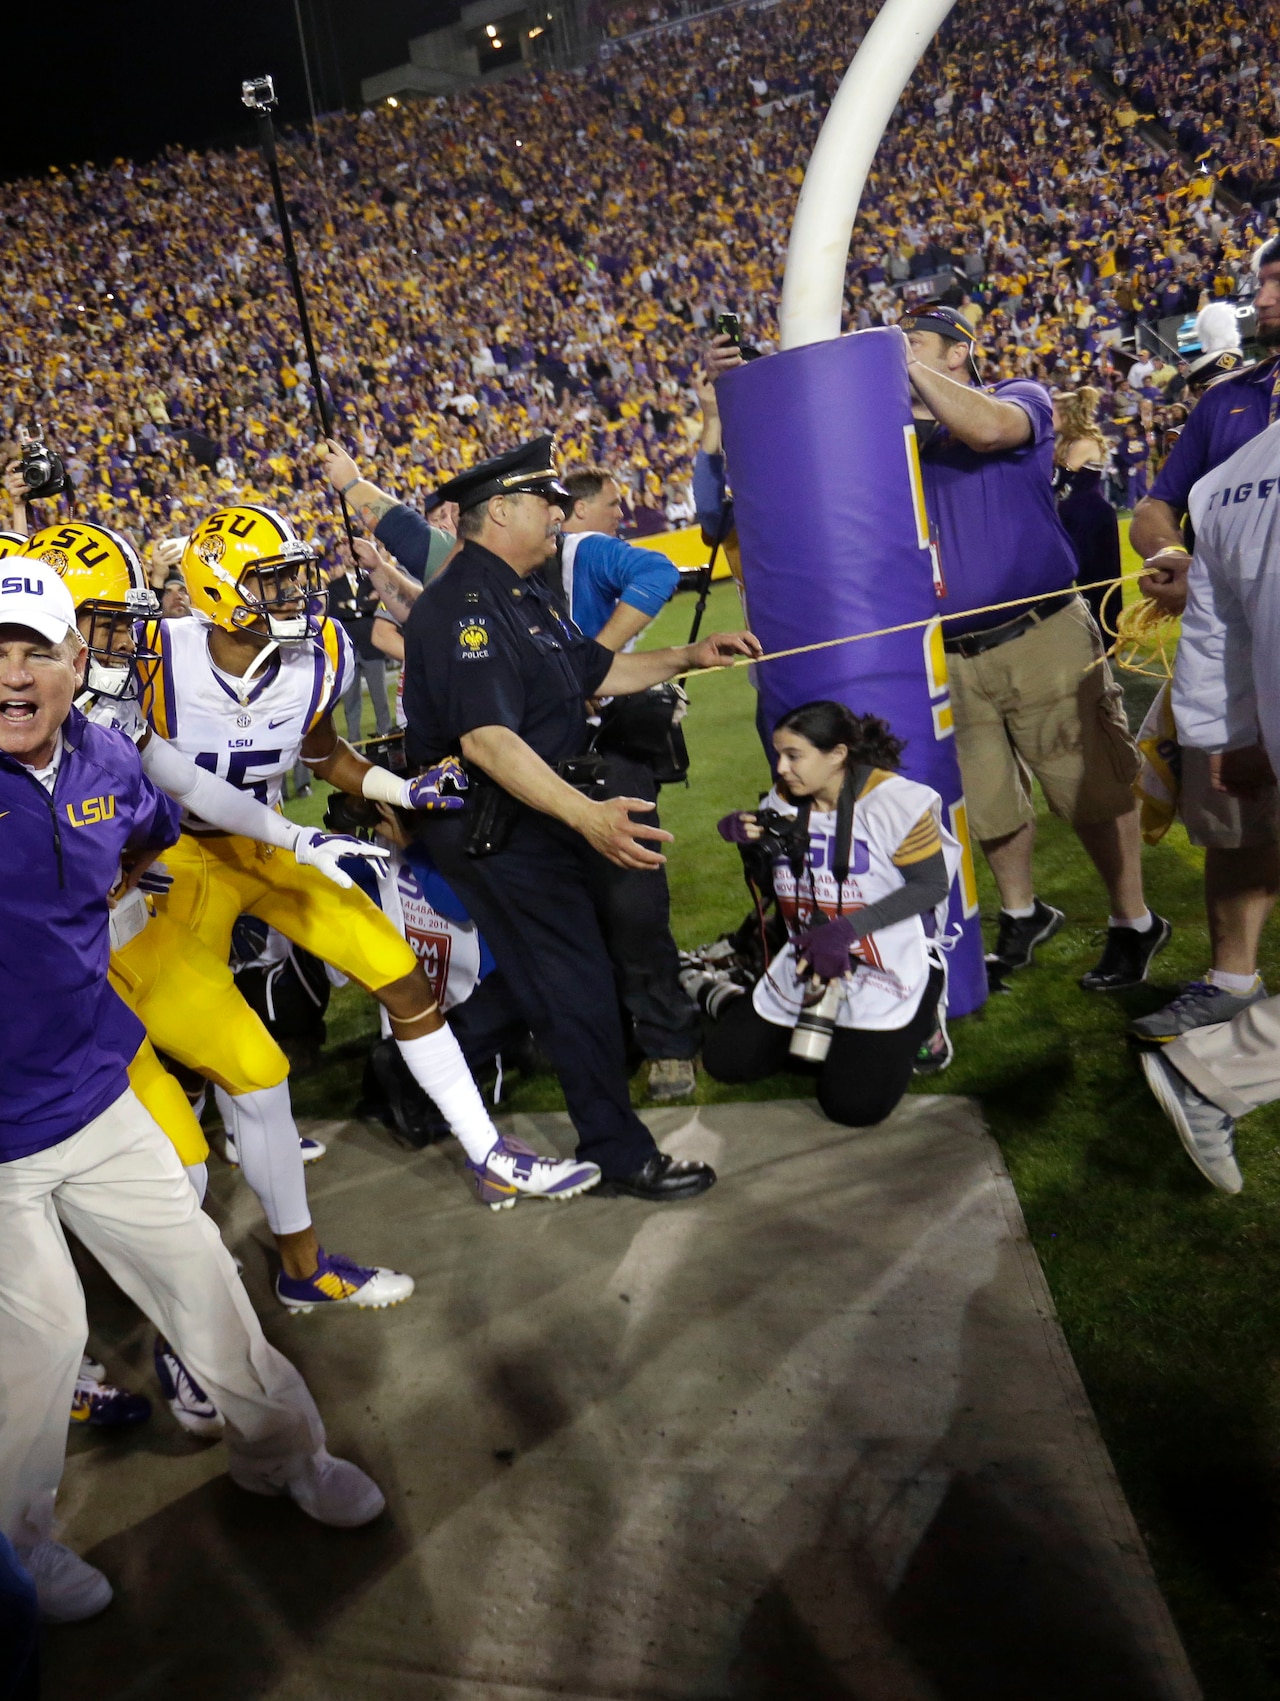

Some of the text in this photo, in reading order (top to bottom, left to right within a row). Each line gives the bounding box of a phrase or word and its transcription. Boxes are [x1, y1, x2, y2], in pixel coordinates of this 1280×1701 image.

[1209, 477, 1280, 510] TIGE
[24, 528, 109, 568] LSU
[459, 618, 486, 628] LSU
[462, 650, 489, 659] POLICE
[228, 739, 253, 748] LSU
[66, 794, 115, 828] LSU
[405, 901, 436, 916] ALABA
[429, 920, 449, 930] 2014
[409, 936, 439, 960] RM
